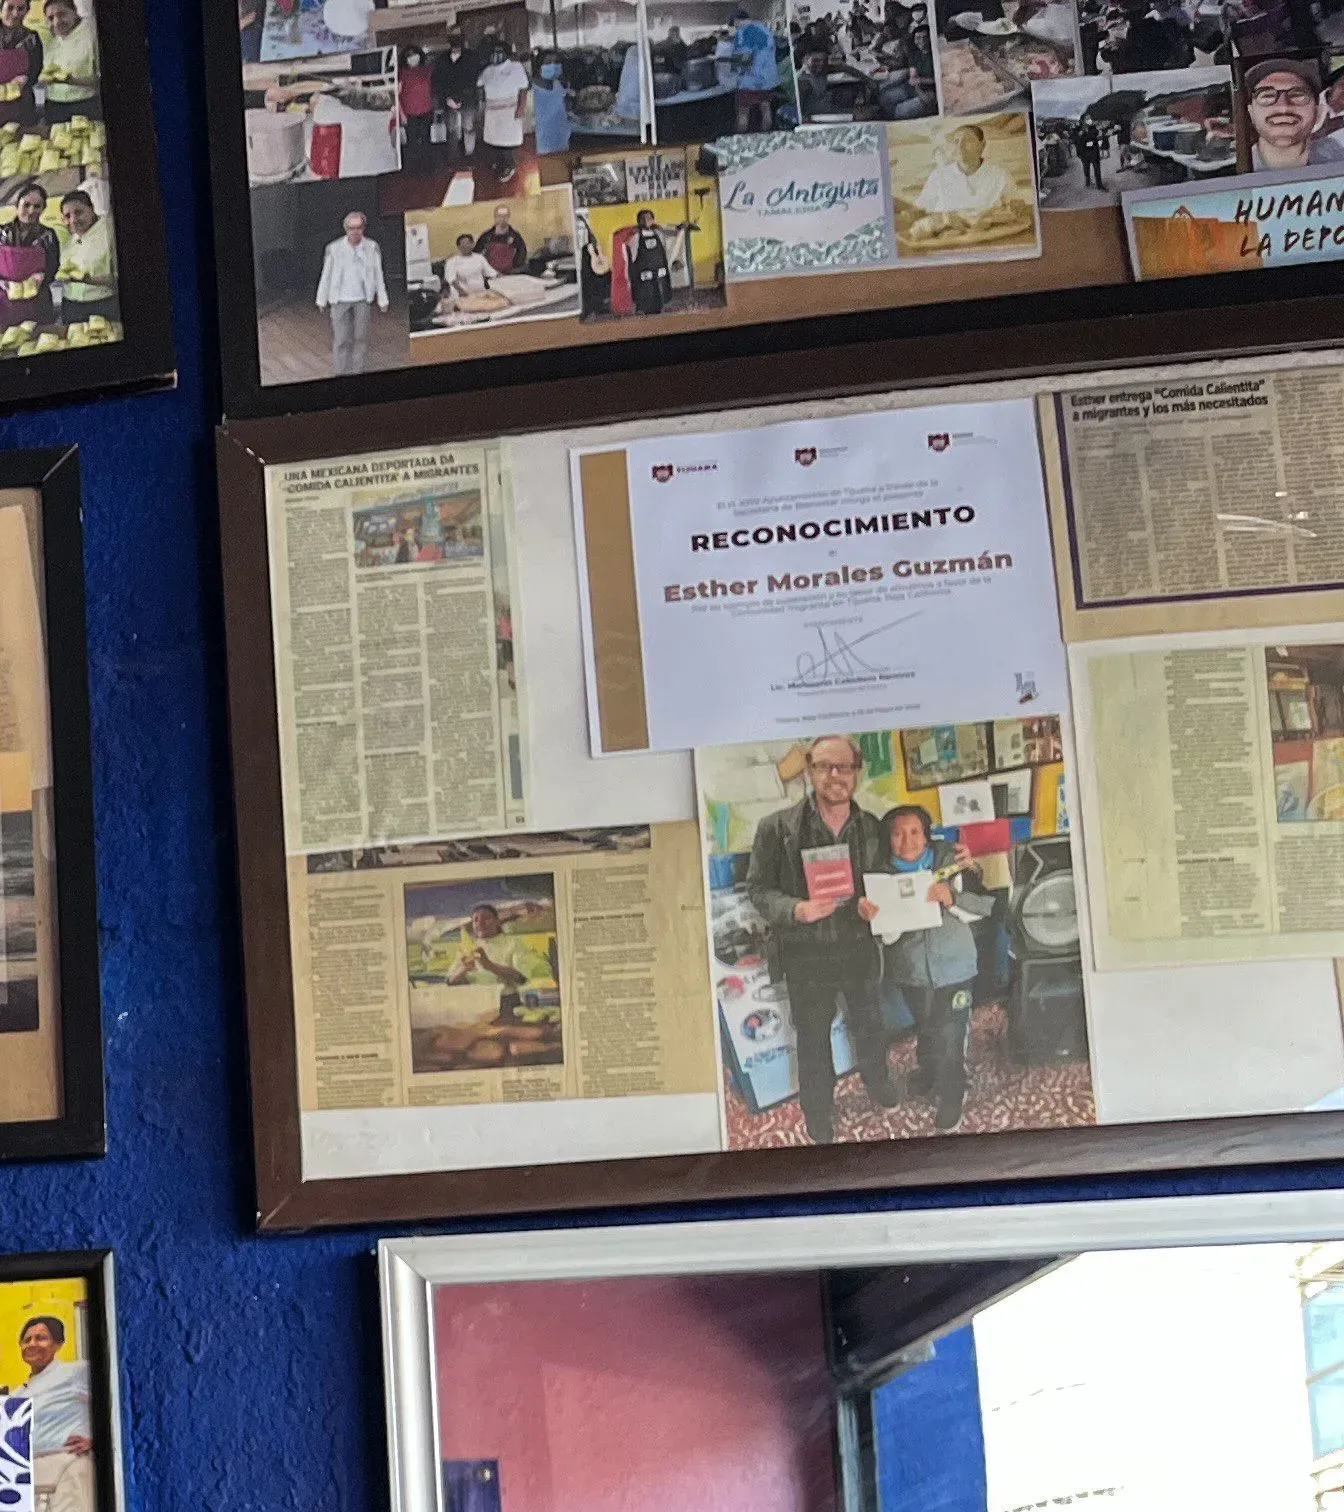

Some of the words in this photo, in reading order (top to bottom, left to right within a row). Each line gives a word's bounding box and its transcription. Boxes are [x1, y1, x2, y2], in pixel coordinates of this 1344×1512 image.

[724, 180, 755, 212] La
[1240, 232, 1272, 258] LA
[1072, 411, 1080, 422] a
[1082, 405, 1140, 422] migrantes
[1143, 405, 1151, 418] y
[1153, 402, 1170, 414] los
[1172, 398, 1196, 412] más
[1198, 394, 1269, 411] necesitados
[413, 463, 480, 480] MIGRANTES
[691, 504, 976, 553] RECONOCIMIENTO
[664, 576, 758, 604] Esther
[768, 563, 884, 593] Morales
[892, 549, 1014, 578] Guzmán
